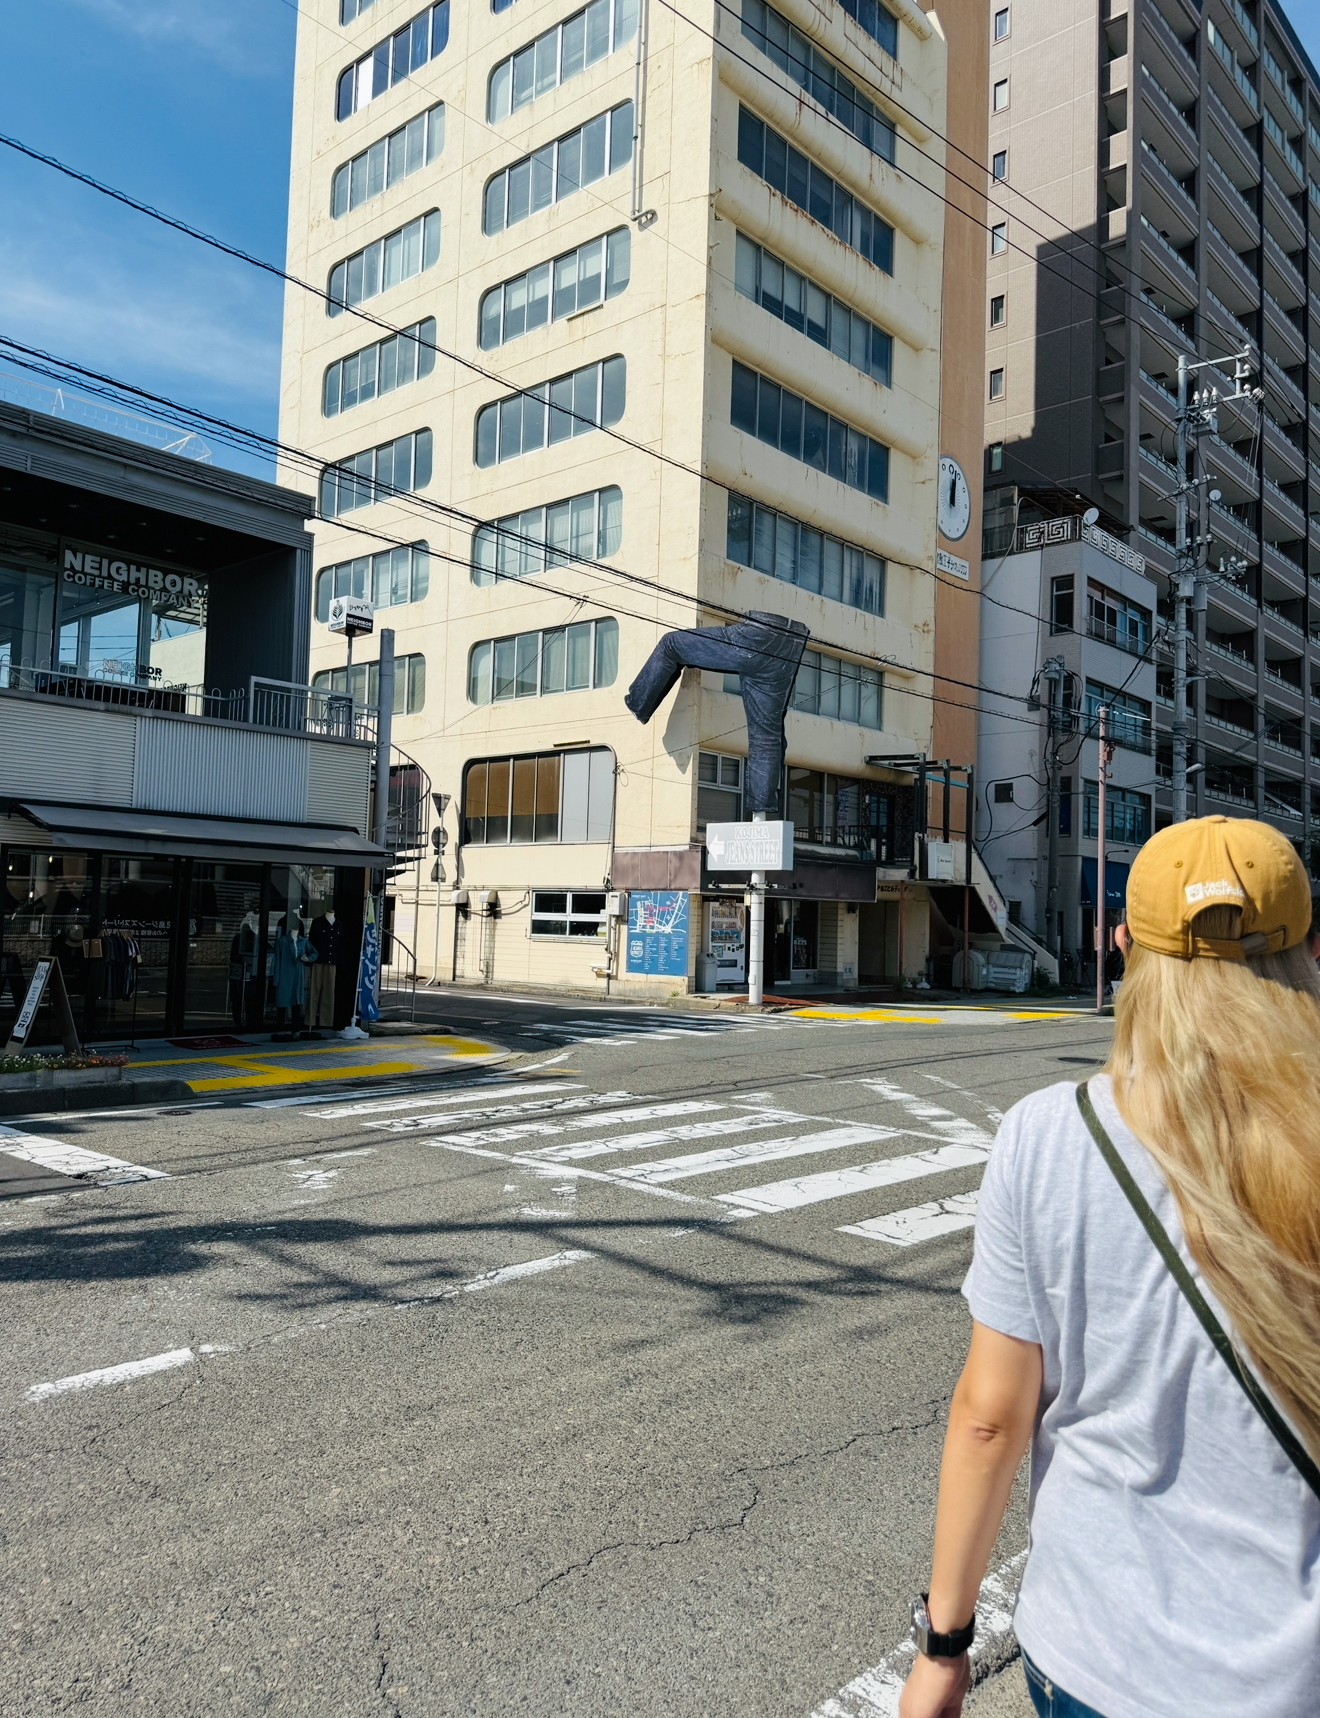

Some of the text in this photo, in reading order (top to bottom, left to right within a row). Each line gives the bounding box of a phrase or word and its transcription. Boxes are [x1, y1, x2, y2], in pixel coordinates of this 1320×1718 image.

[64, 549, 199, 598] NEIGHBOR
[63, 570, 198, 608] COFFEE COMPANY
[735, 826, 769, 839] KOJIMA
[725, 839, 779, 865] JEANS STREET
[1203, 879, 1228, 889] Jack
[1204, 886, 1245, 897] Wolfsk
